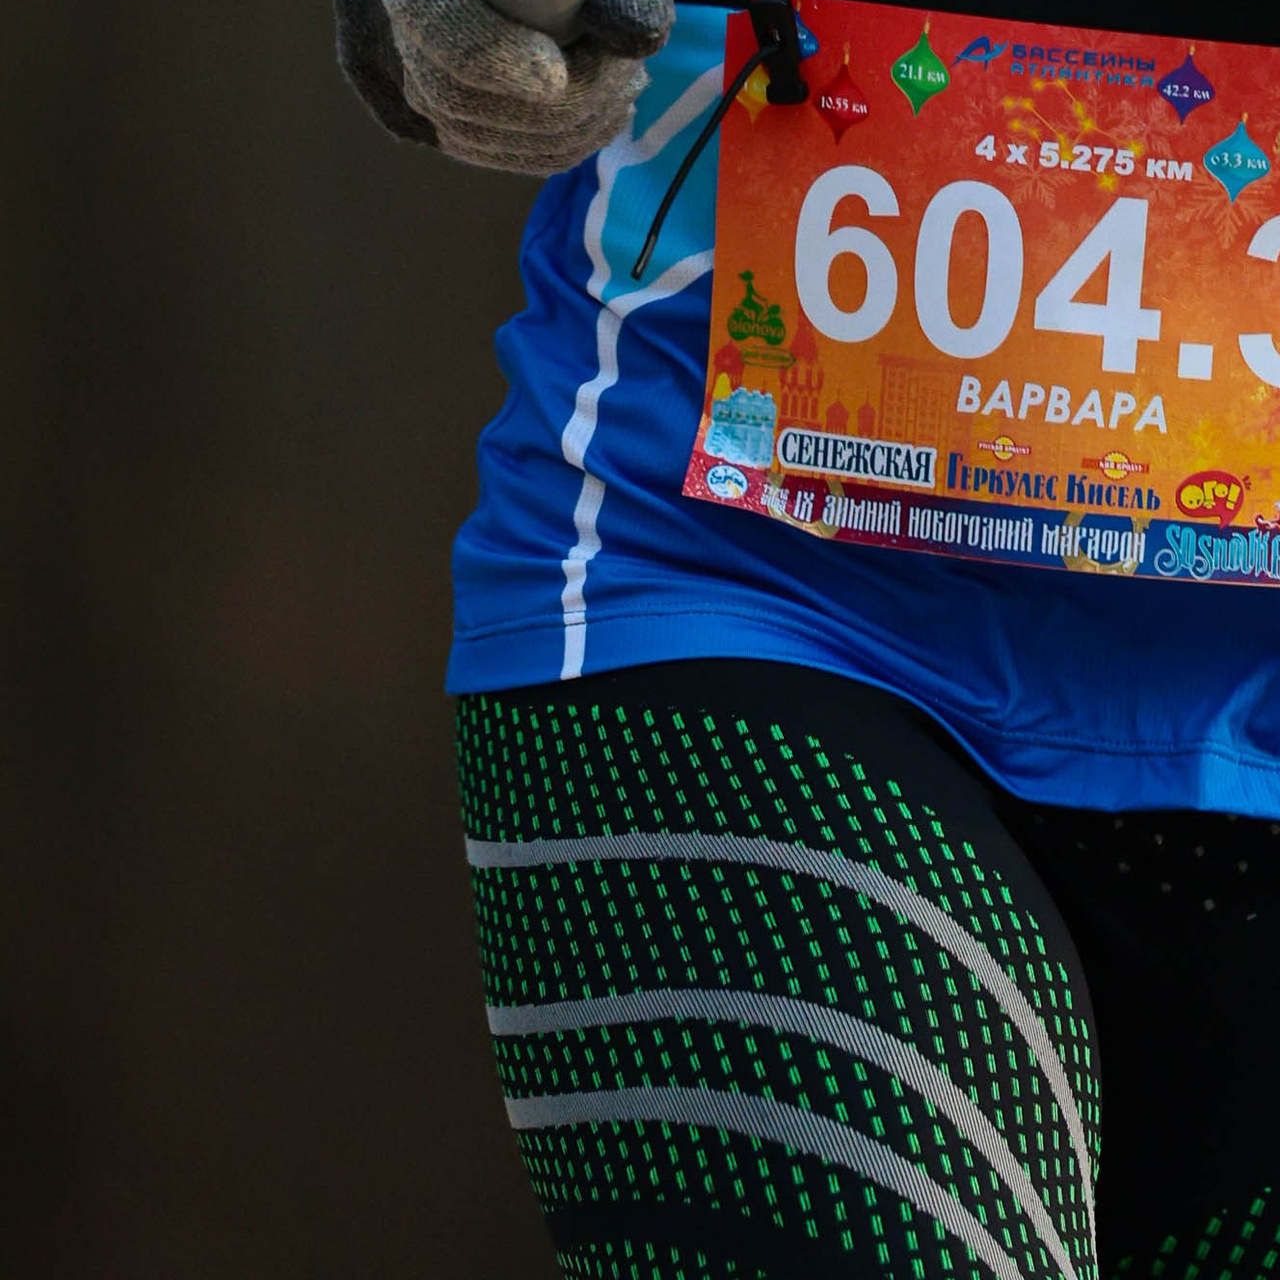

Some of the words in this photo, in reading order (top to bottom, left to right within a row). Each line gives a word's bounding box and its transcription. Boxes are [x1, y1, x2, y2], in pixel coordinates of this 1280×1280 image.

[899, 62, 922, 81] 21.1
[1011, 43, 1157, 73] БАССЕЙНЫ
[1010, 61, 1156, 89] АТЛАНТИКА
[820, 95, 849, 112] 10.55
[1161, 83, 1190, 100] 42.2
[975, 134, 997, 160] 4
[1039, 140, 1135, 176] 5.275
[956, 374, 1169, 435] ВАРВАРА
[780, 431, 934, 484] СЕНЕЖСКАЯ
[824, 494, 902, 536] ЗИМНИЙ
[1040, 521, 1147, 564] МАРАФОН
